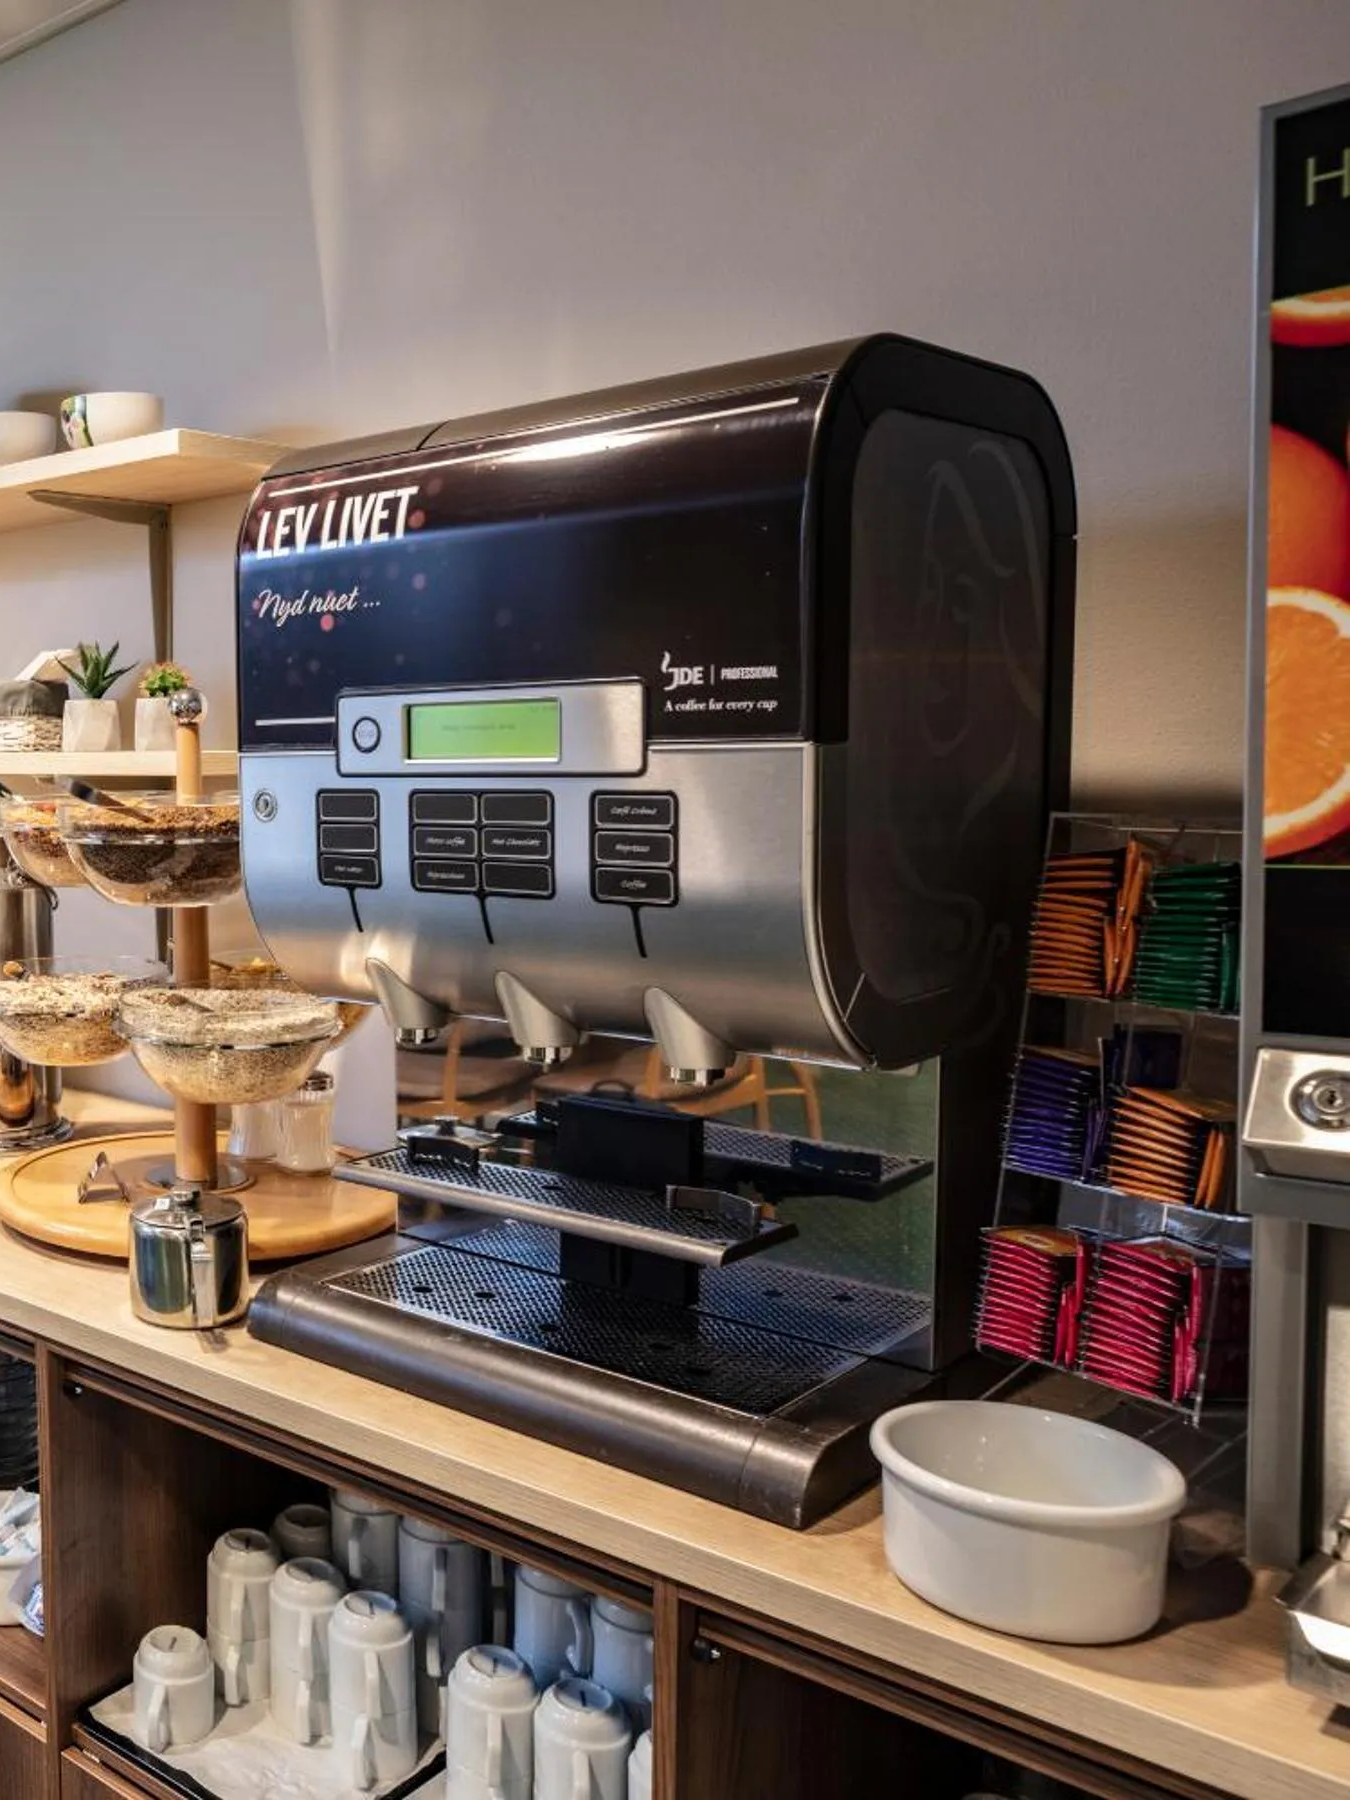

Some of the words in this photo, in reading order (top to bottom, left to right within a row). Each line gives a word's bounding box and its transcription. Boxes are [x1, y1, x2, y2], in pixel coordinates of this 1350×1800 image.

[256, 502, 319, 560] LEV
[320, 485, 420, 550] LIVET
[257, 588, 309, 627] Nyd
[720, 665, 778, 680] PROFESSIONAL
[664, 700, 673, 712] A
[675, 698, 707, 712] coffee
[708, 698, 724, 711] for
[725, 700, 754, 712] every
[756, 699, 778, 712] cup
